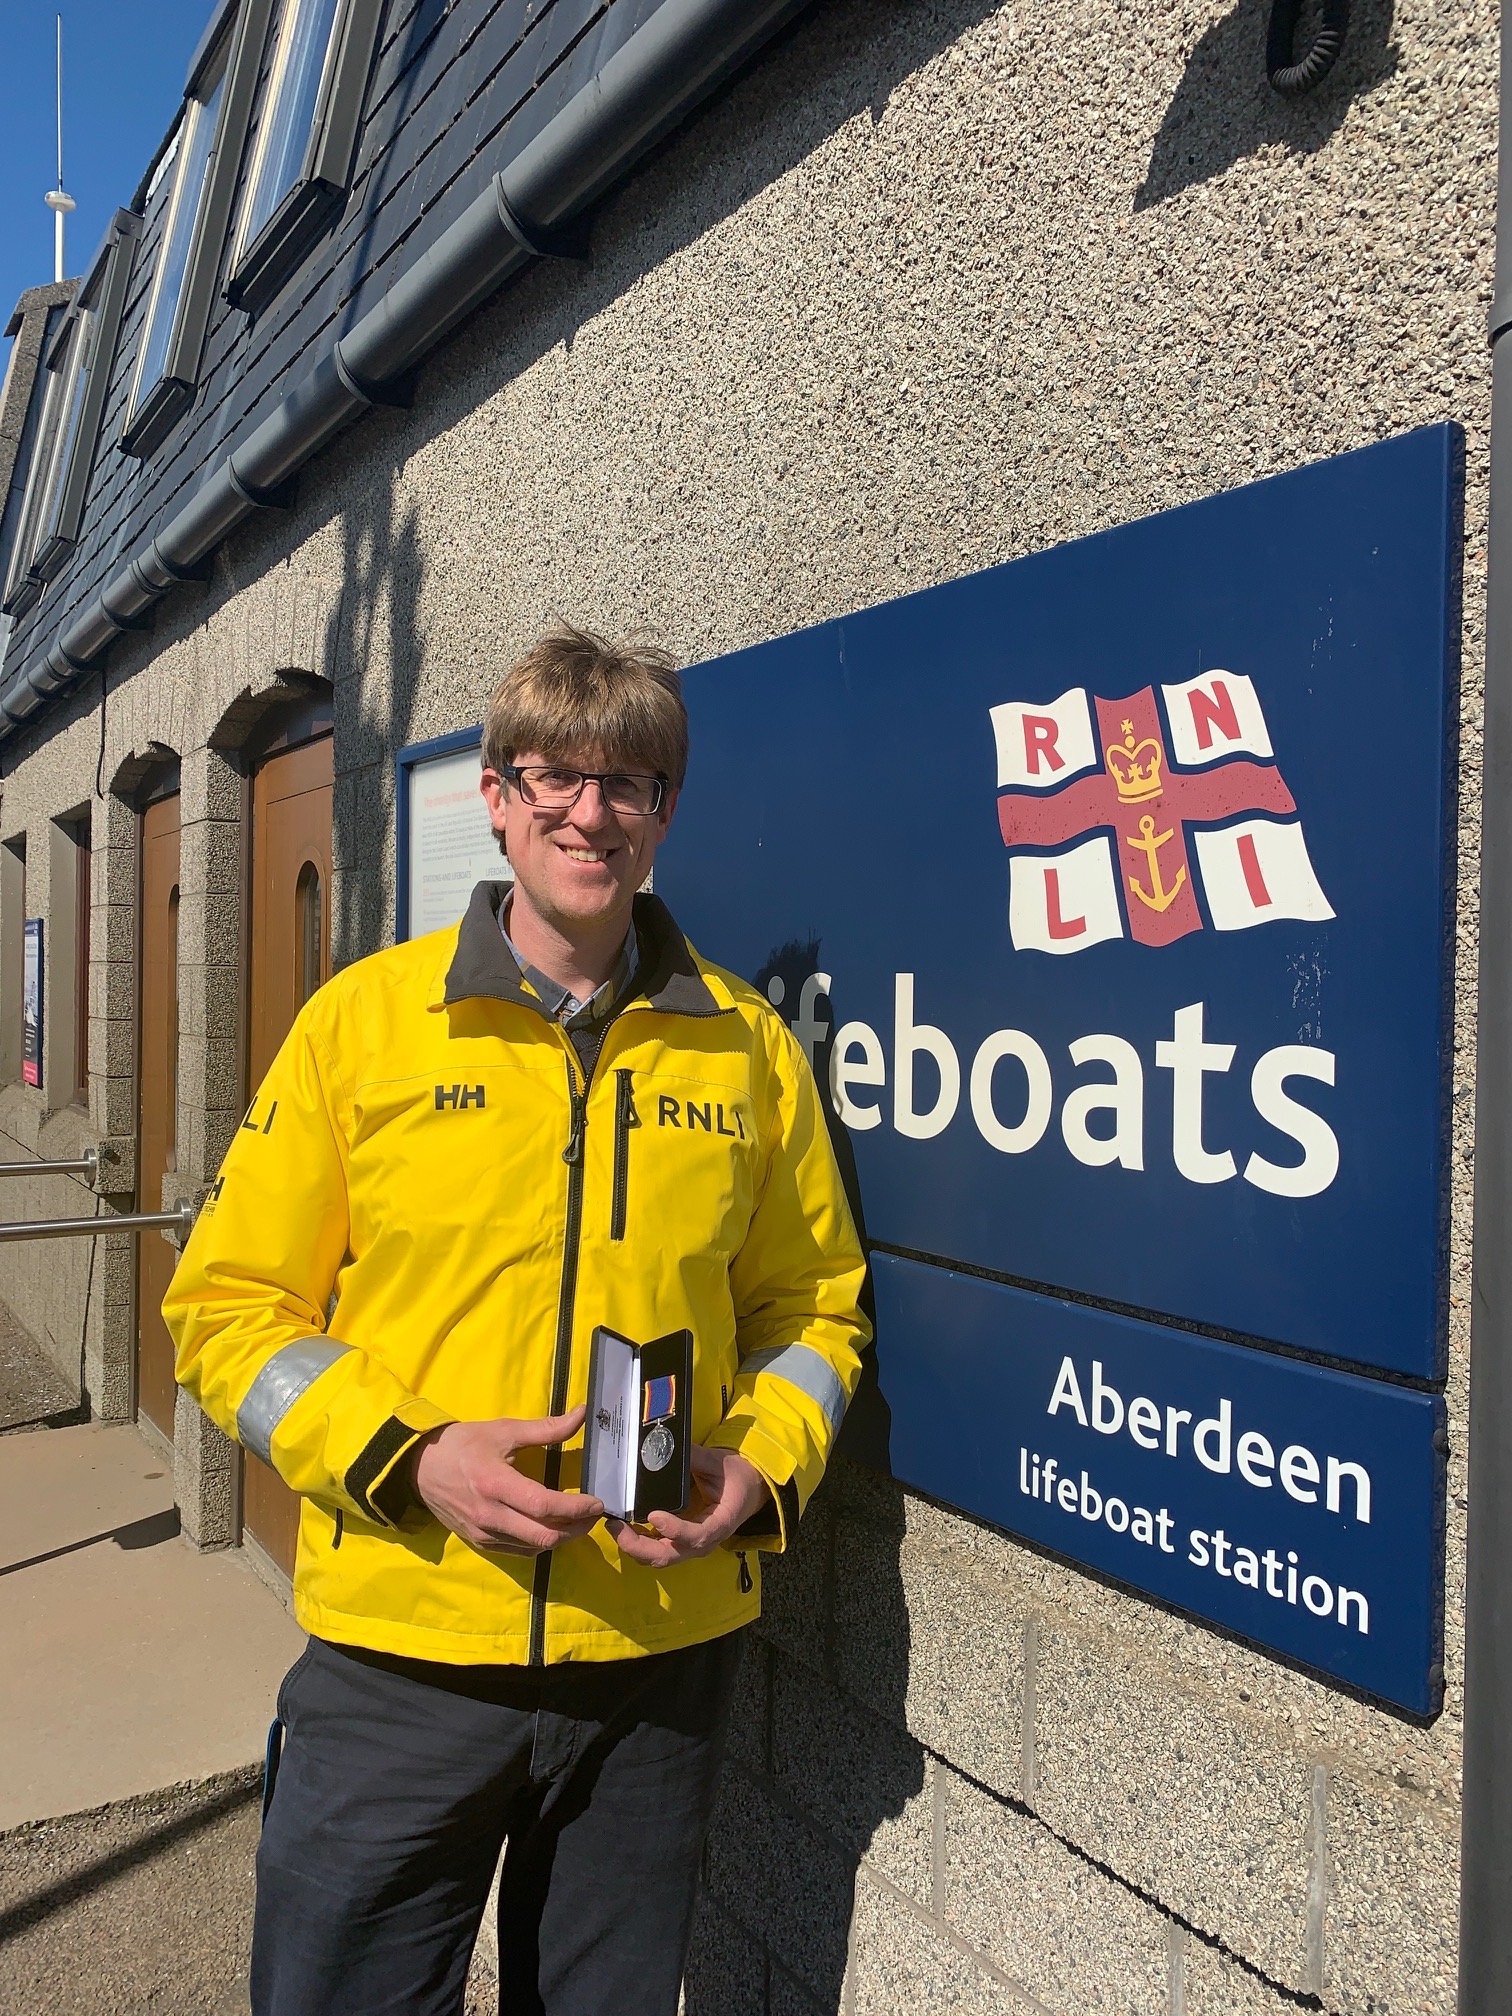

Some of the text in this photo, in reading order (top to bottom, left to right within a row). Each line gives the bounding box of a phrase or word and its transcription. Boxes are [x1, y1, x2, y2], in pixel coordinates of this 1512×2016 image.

[241, 1095, 278, 1135] LI
[434, 1084, 486, 1111] HH
[658, 1094, 745, 1140] RNLI
[767, 972, 1340, 1198] feboats
[1046, 1355, 1372, 1524] Aberdeen
[1019, 1446, 1370, 1635] lifeboat station
